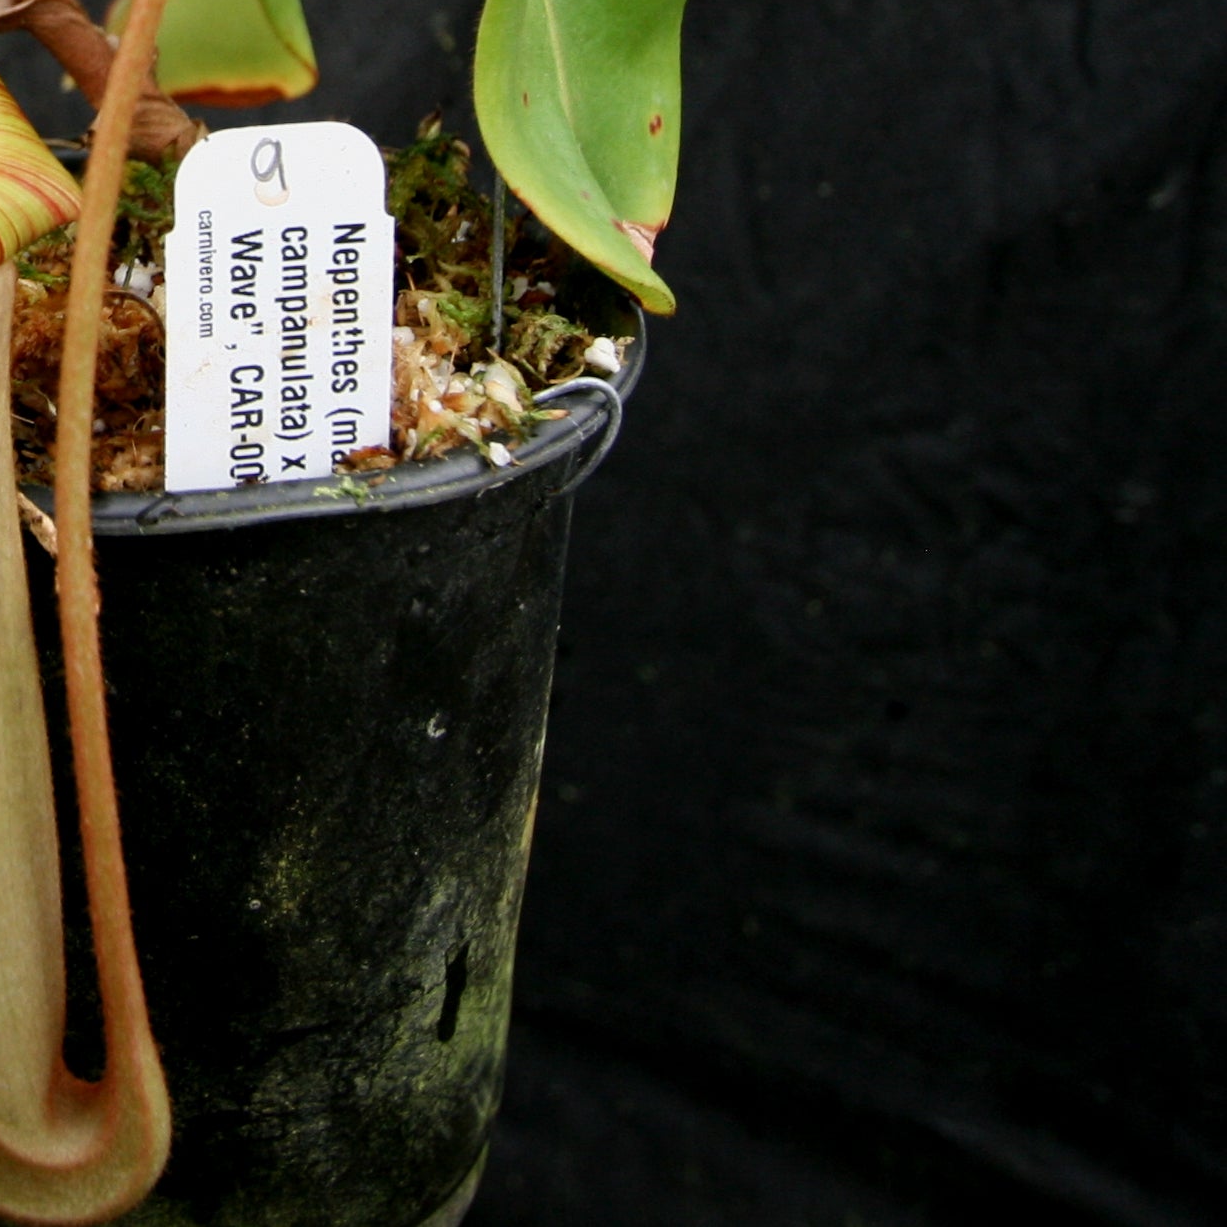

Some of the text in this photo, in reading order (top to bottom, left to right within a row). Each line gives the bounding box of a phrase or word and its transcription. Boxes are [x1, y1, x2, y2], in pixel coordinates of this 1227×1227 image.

[198, 209, 217, 338] carnivero.com
[229, 229, 264, 335] Wave"
[325, 223, 366, 394] Nepenthes
[274, 226, 314, 472] campanulata) x
